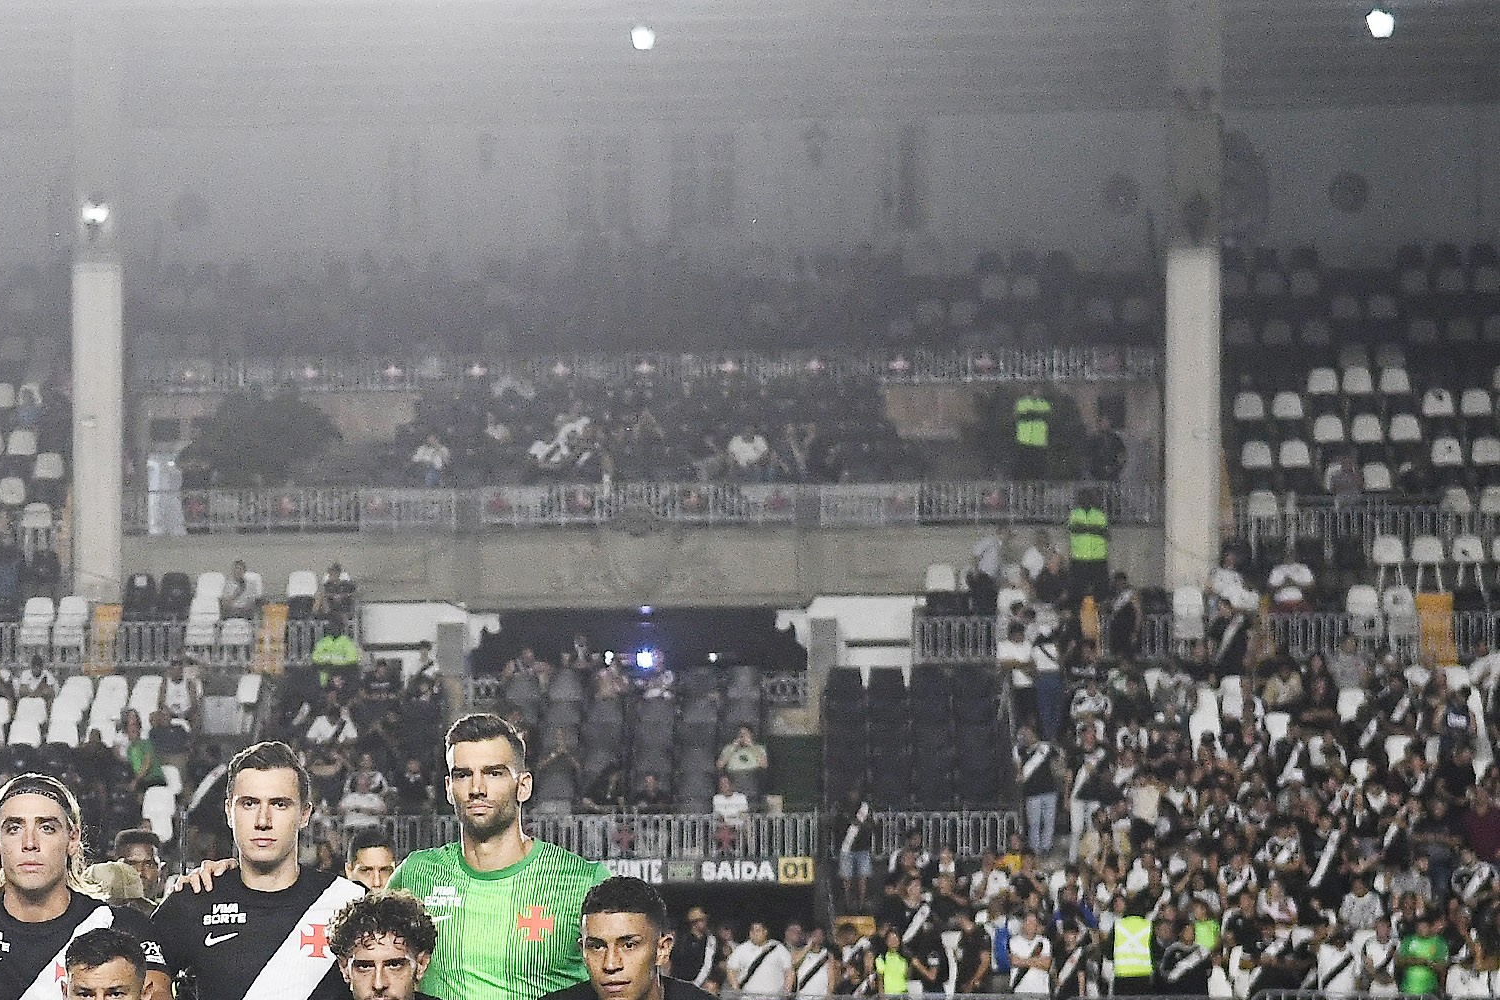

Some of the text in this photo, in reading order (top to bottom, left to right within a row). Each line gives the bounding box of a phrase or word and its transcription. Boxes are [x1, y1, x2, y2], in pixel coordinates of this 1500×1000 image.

[783, 862, 808, 880] 01
[212, 903, 239, 914] VIVA
[203, 912, 247, 926] SORTE
